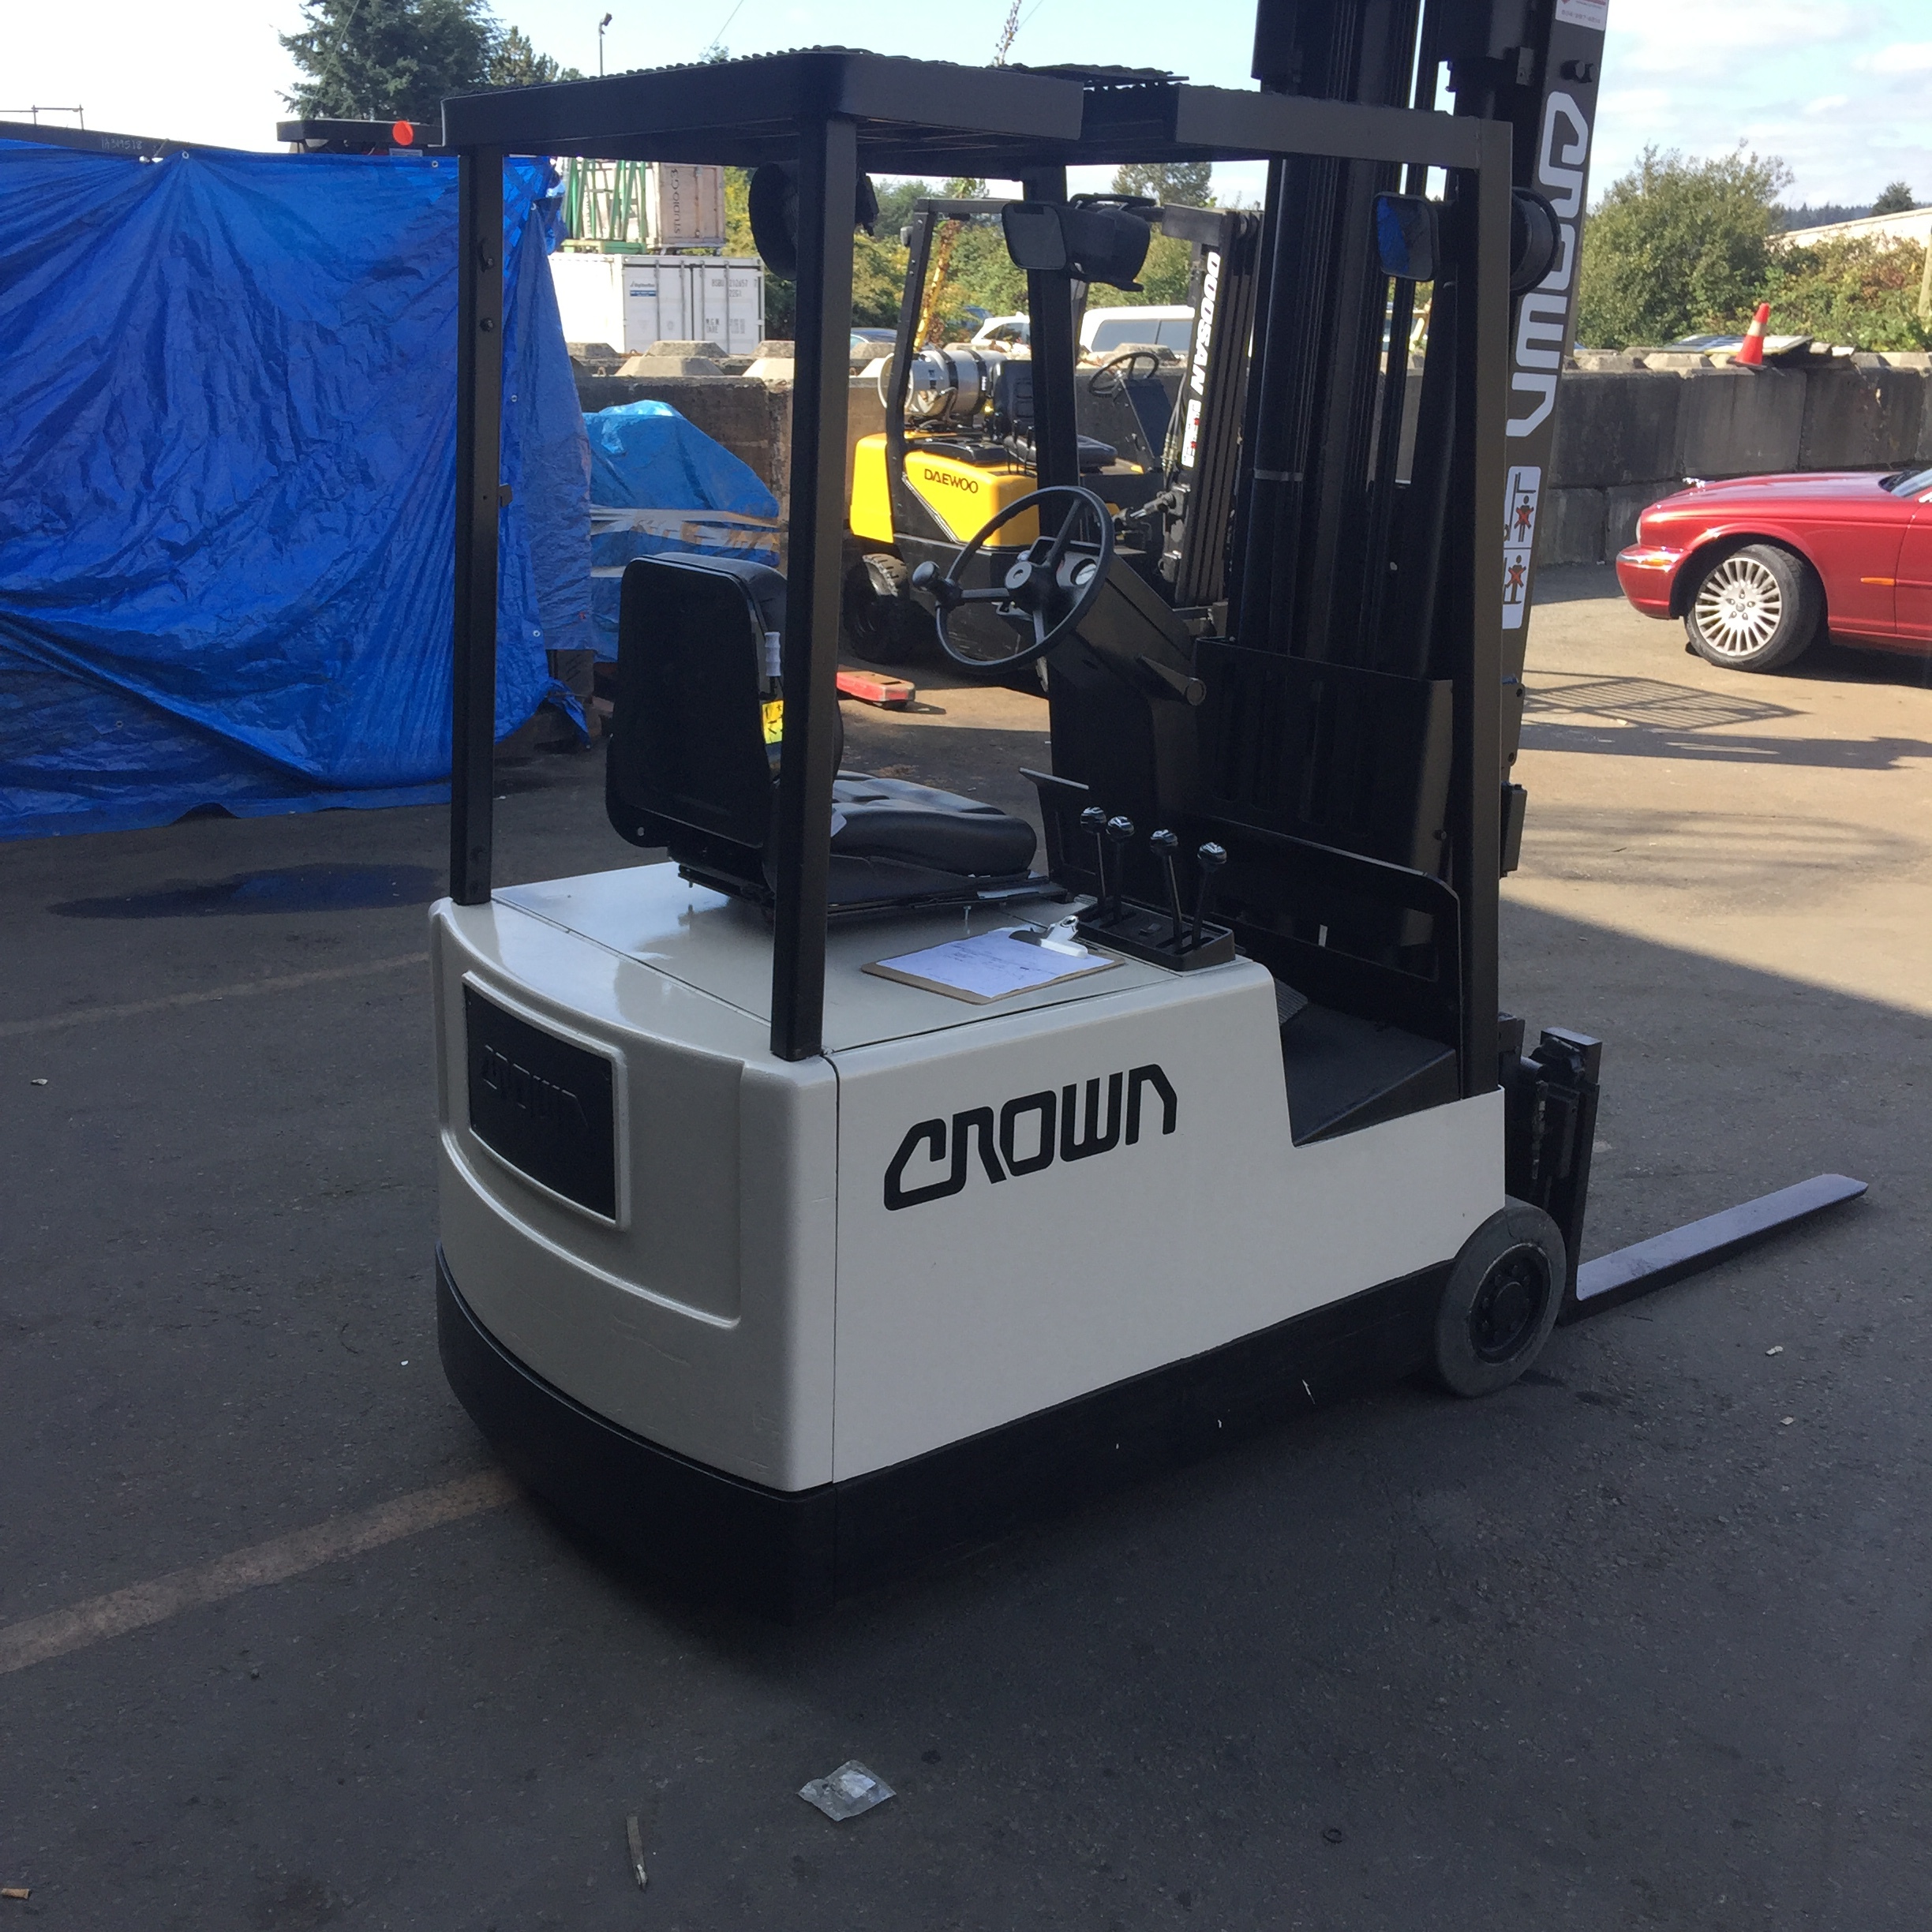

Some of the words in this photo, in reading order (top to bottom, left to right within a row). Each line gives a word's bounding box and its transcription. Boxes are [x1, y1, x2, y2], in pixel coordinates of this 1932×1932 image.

[672, 191, 681, 234] STUDIO
[1506, 91, 1589, 437] CROWN
[1190, 251, 1221, 396] DOOSAN
[924, 468, 979, 494] DAEWOO
[884, 1063, 1178, 1211] CROWN
